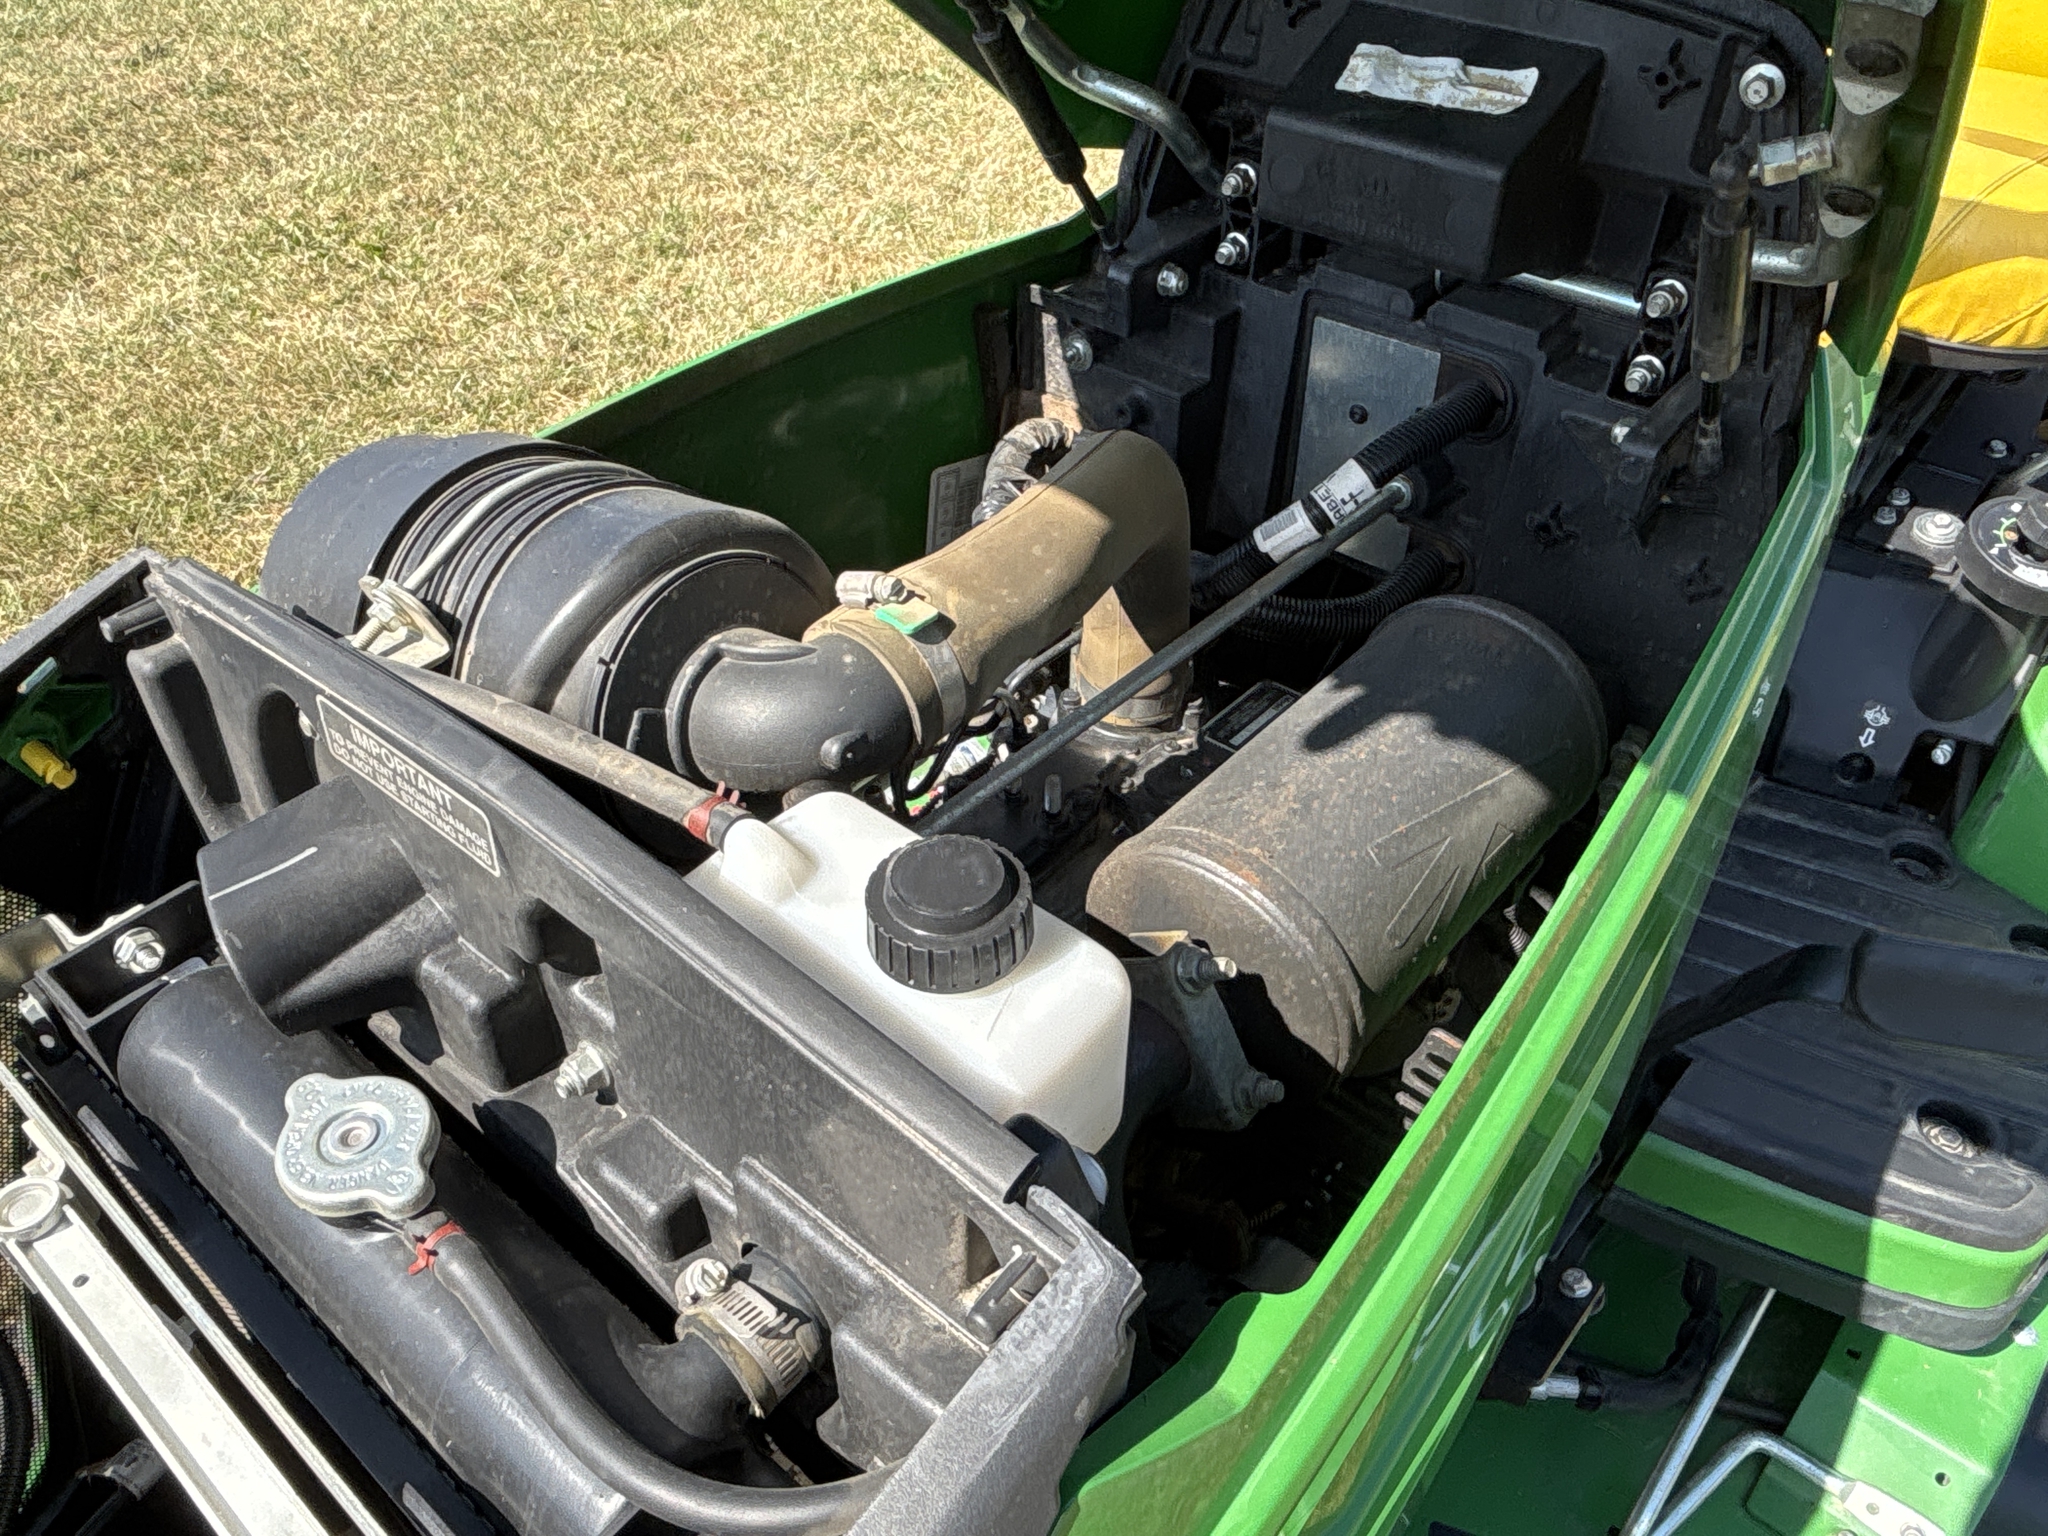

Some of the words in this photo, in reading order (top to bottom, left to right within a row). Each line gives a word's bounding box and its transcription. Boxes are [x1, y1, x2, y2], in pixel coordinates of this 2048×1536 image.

[328, 728, 345, 745] TO
[346, 743, 394, 780] PREVENT
[396, 776, 439, 811] ENGINE
[440, 809, 489, 852] DAMAGE
[333, 743, 351, 761] DO
[351, 756, 375, 778] NOT
[376, 772, 400, 796] USE
[399, 790, 457, 839] STARTING
[458, 833, 493, 866] FLUID
[349, 724, 453, 812] IMPORTANT
